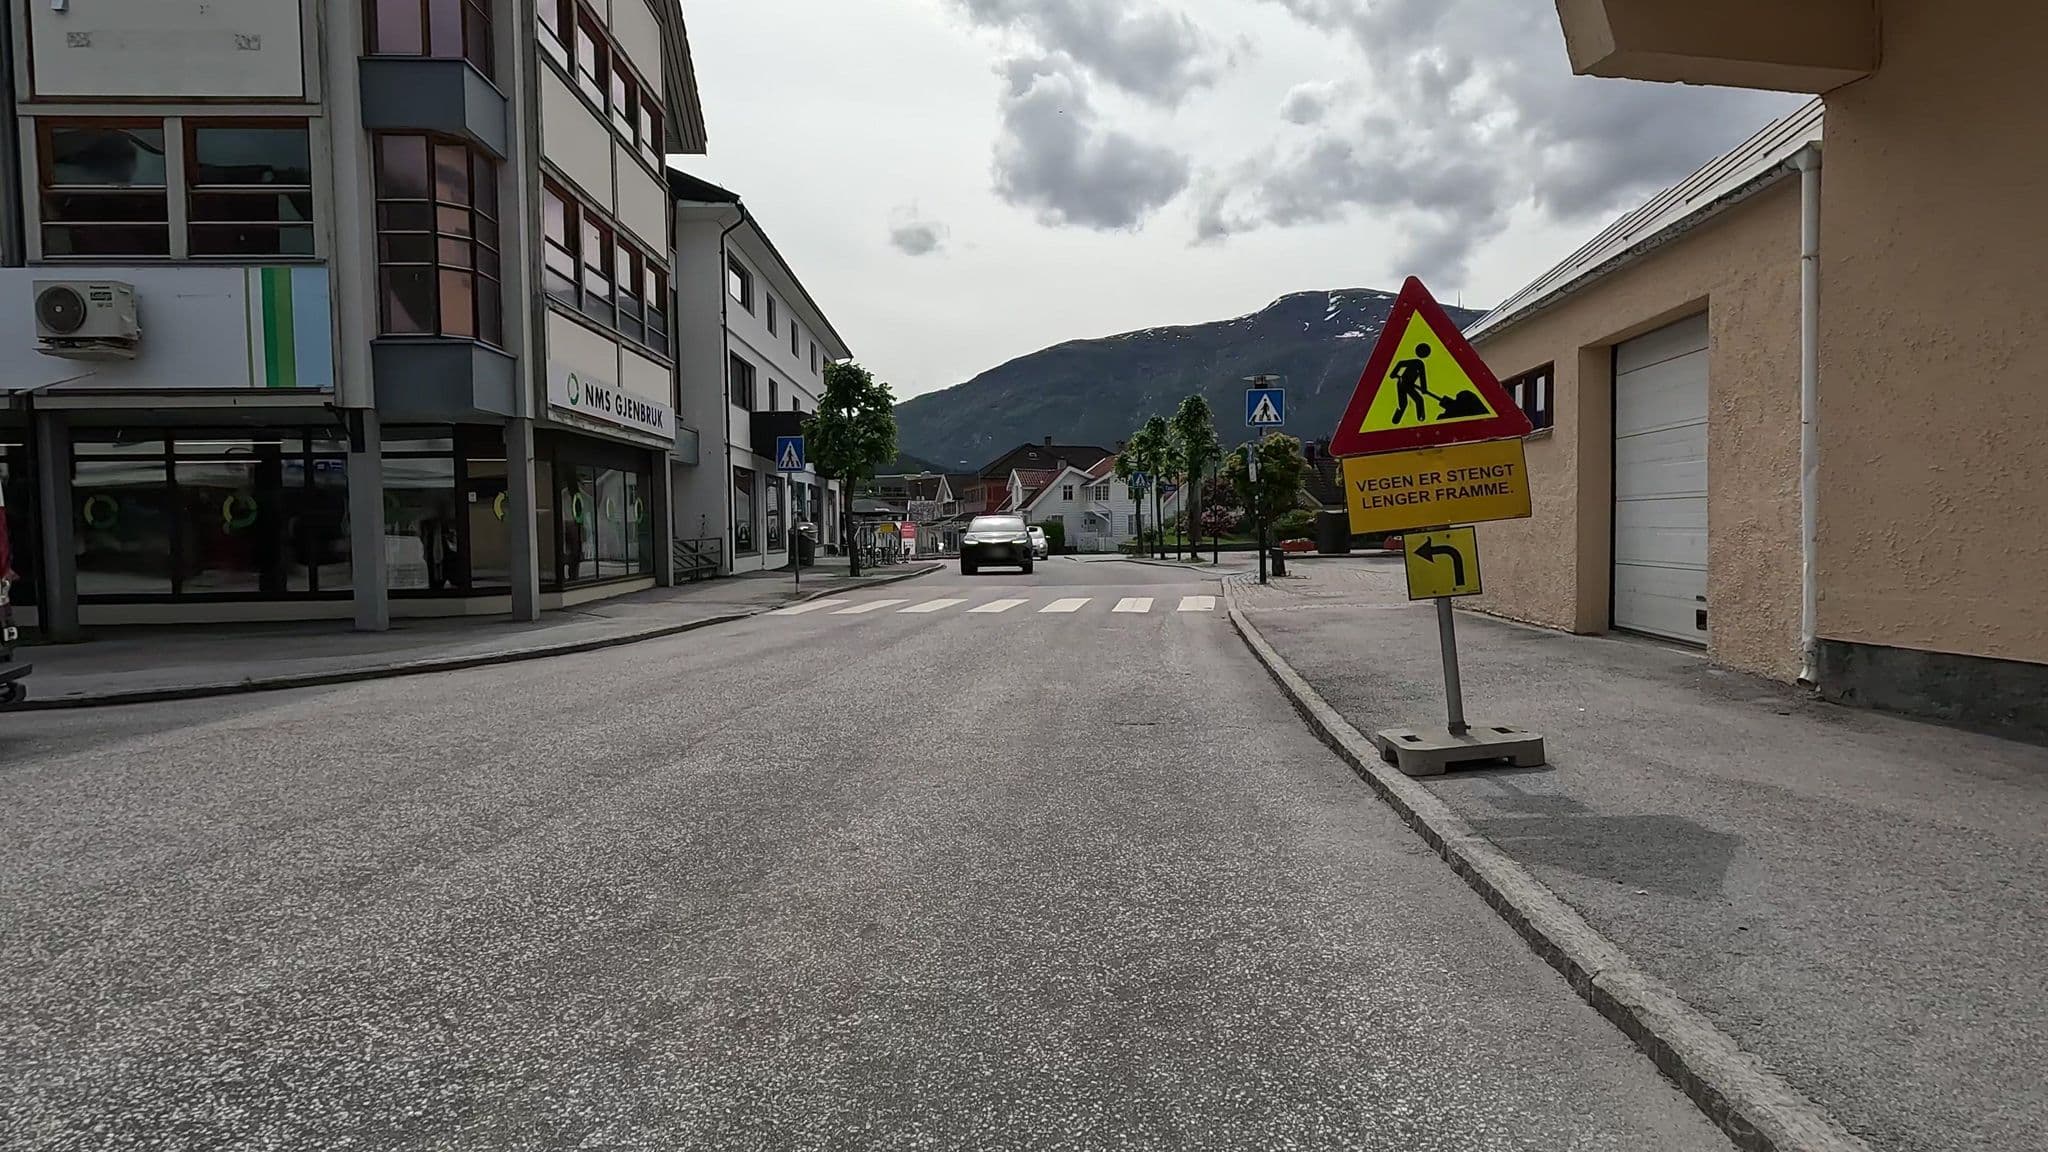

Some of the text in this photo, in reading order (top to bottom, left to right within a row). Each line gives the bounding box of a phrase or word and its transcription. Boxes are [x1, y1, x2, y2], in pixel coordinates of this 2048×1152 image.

[585, 383, 663, 429] NMS GJENBRUK
[1356, 464, 1514, 492] VEGEN ER STENGT
[1362, 482, 1514, 509] LENGER FRAMME.
